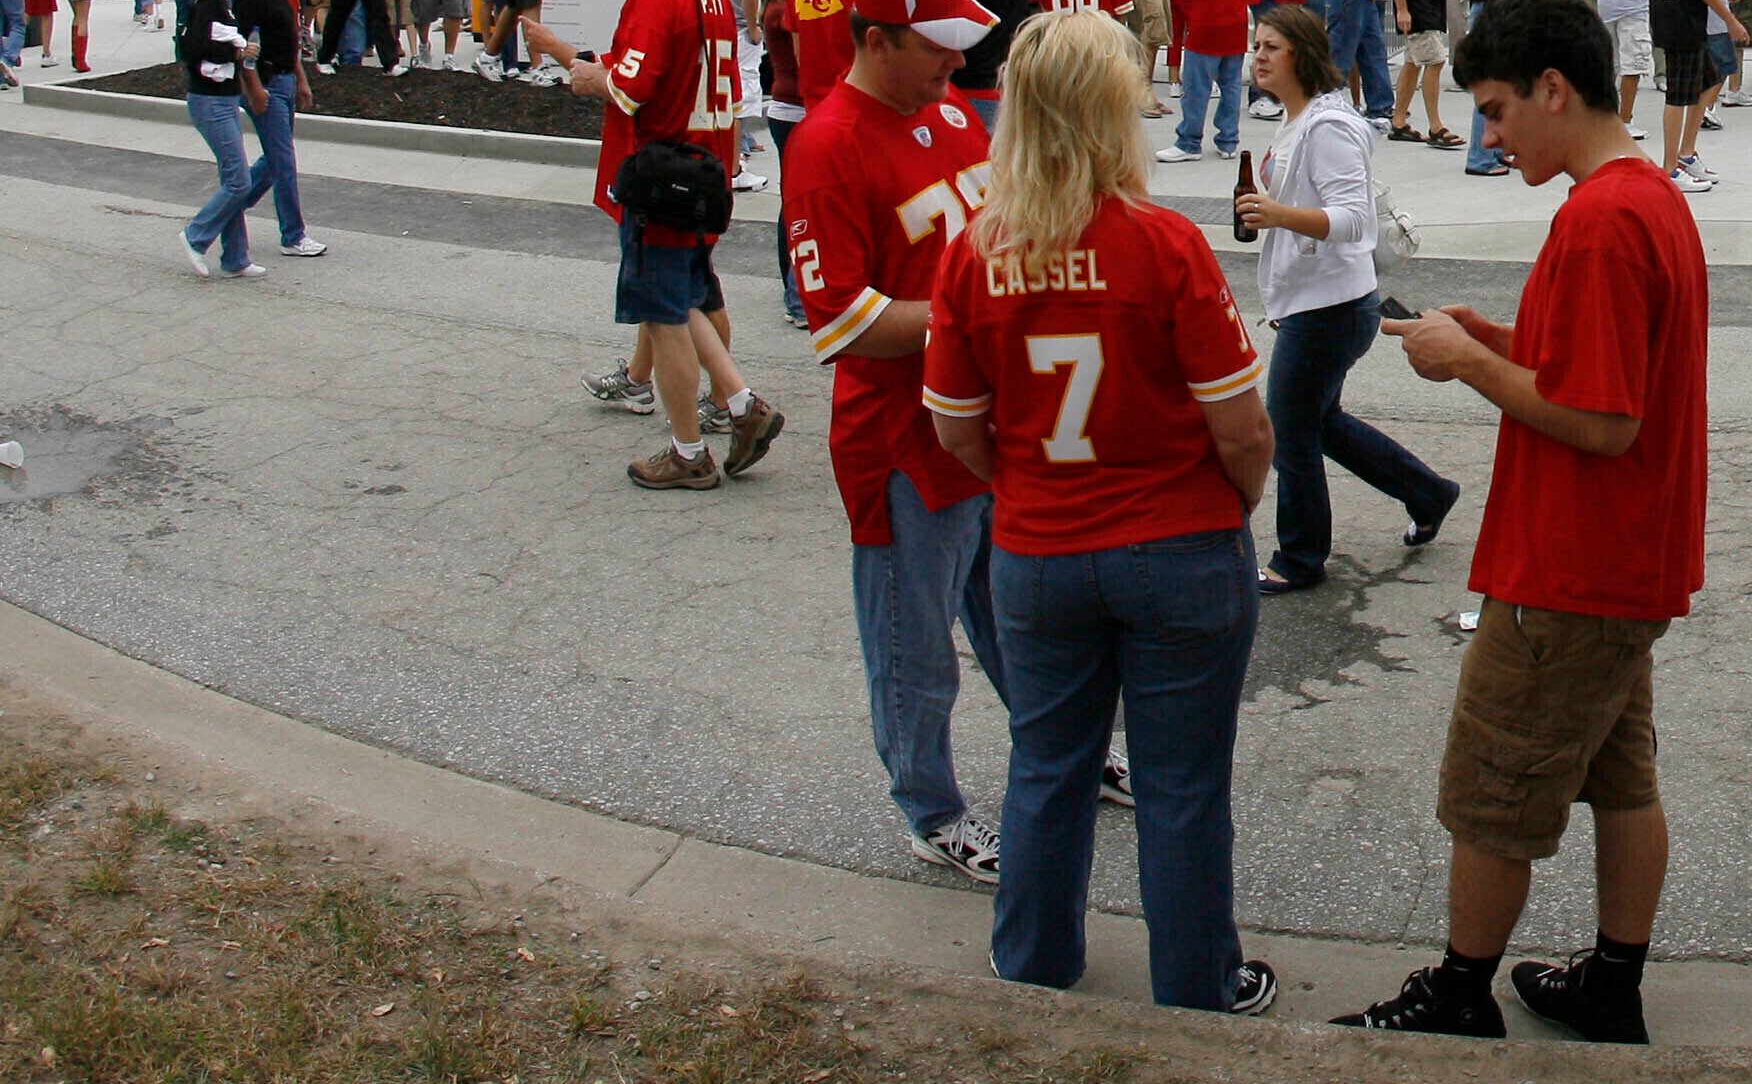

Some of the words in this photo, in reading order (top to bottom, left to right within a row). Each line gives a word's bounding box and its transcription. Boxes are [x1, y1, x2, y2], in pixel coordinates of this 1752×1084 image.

[613, 47, 646, 79] 5
[687, 39, 734, 132] 15
[986, 249, 1107, 298] CASSEL
[1024, 332, 1105, 464] 7
